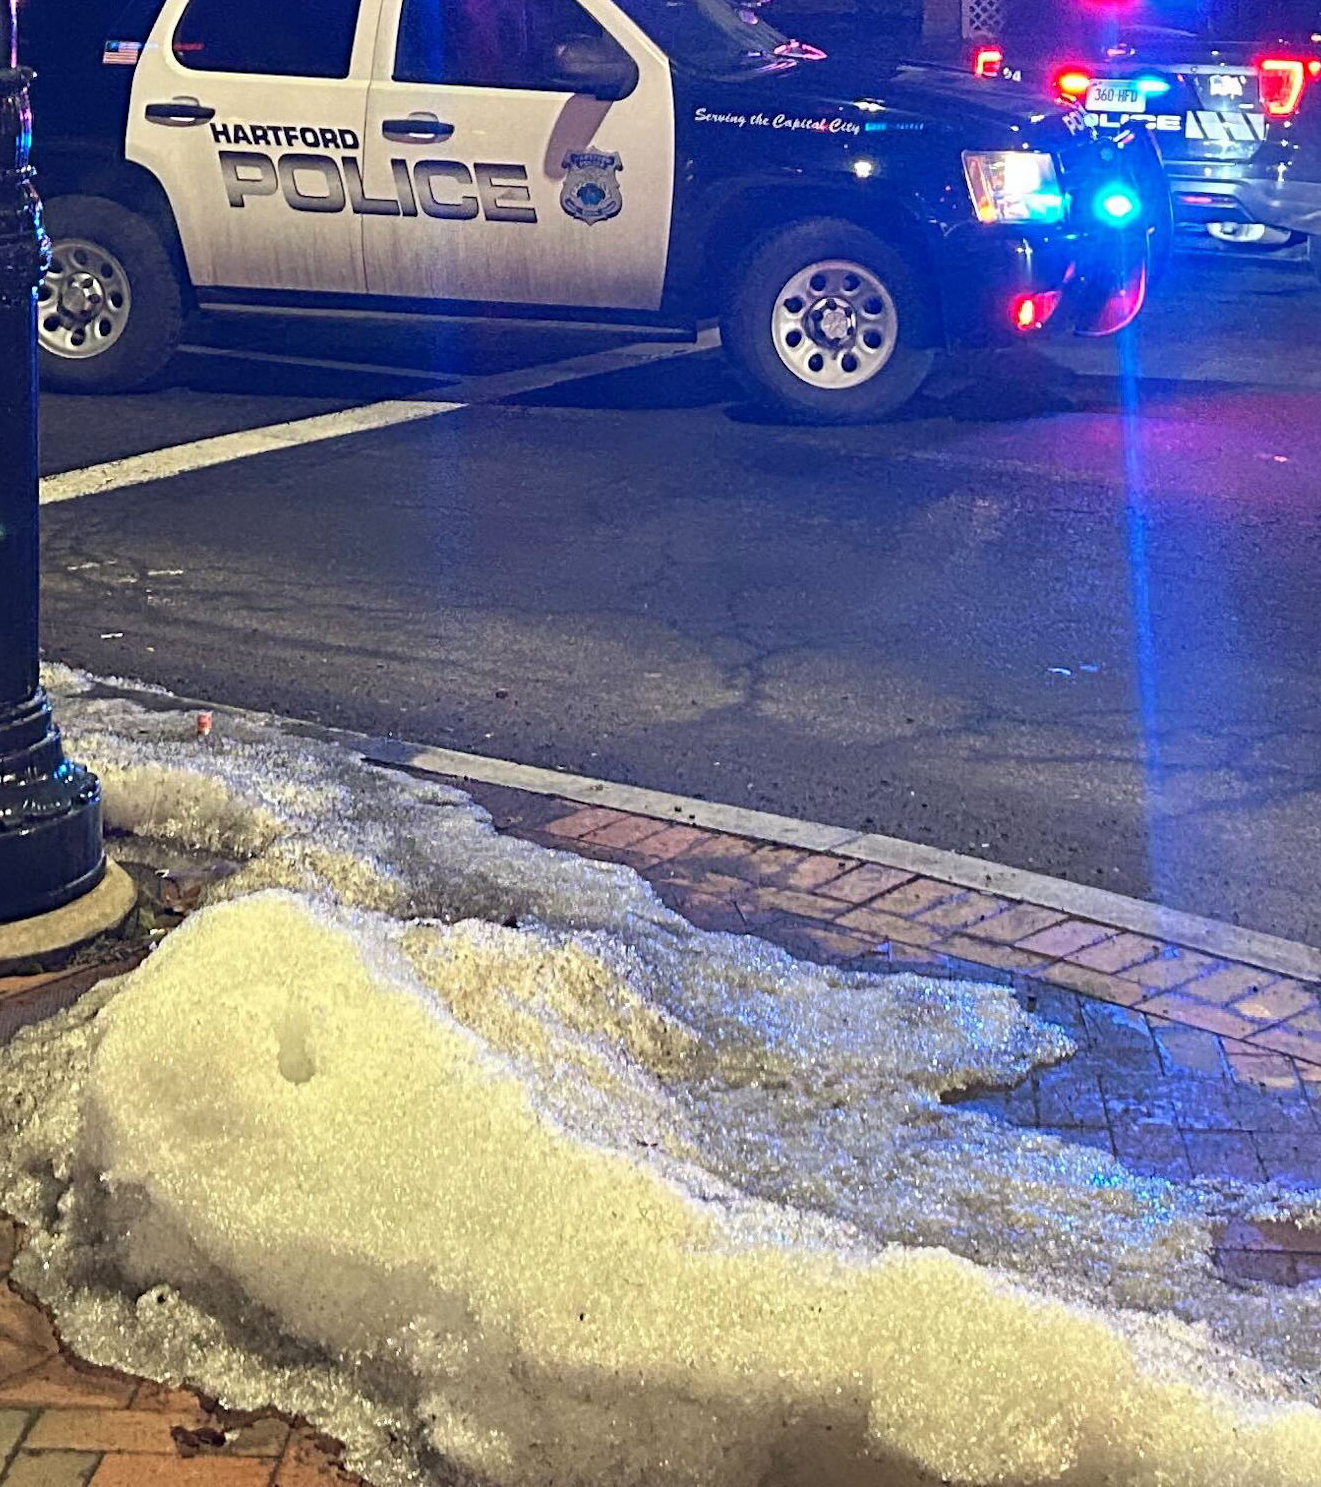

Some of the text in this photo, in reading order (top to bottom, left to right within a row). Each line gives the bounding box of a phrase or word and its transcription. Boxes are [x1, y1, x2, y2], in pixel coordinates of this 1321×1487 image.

[695, 108, 860, 135] Serving the Capital City
[210, 122, 359, 150] HARTFORD
[218, 150, 538, 223] POLICE
